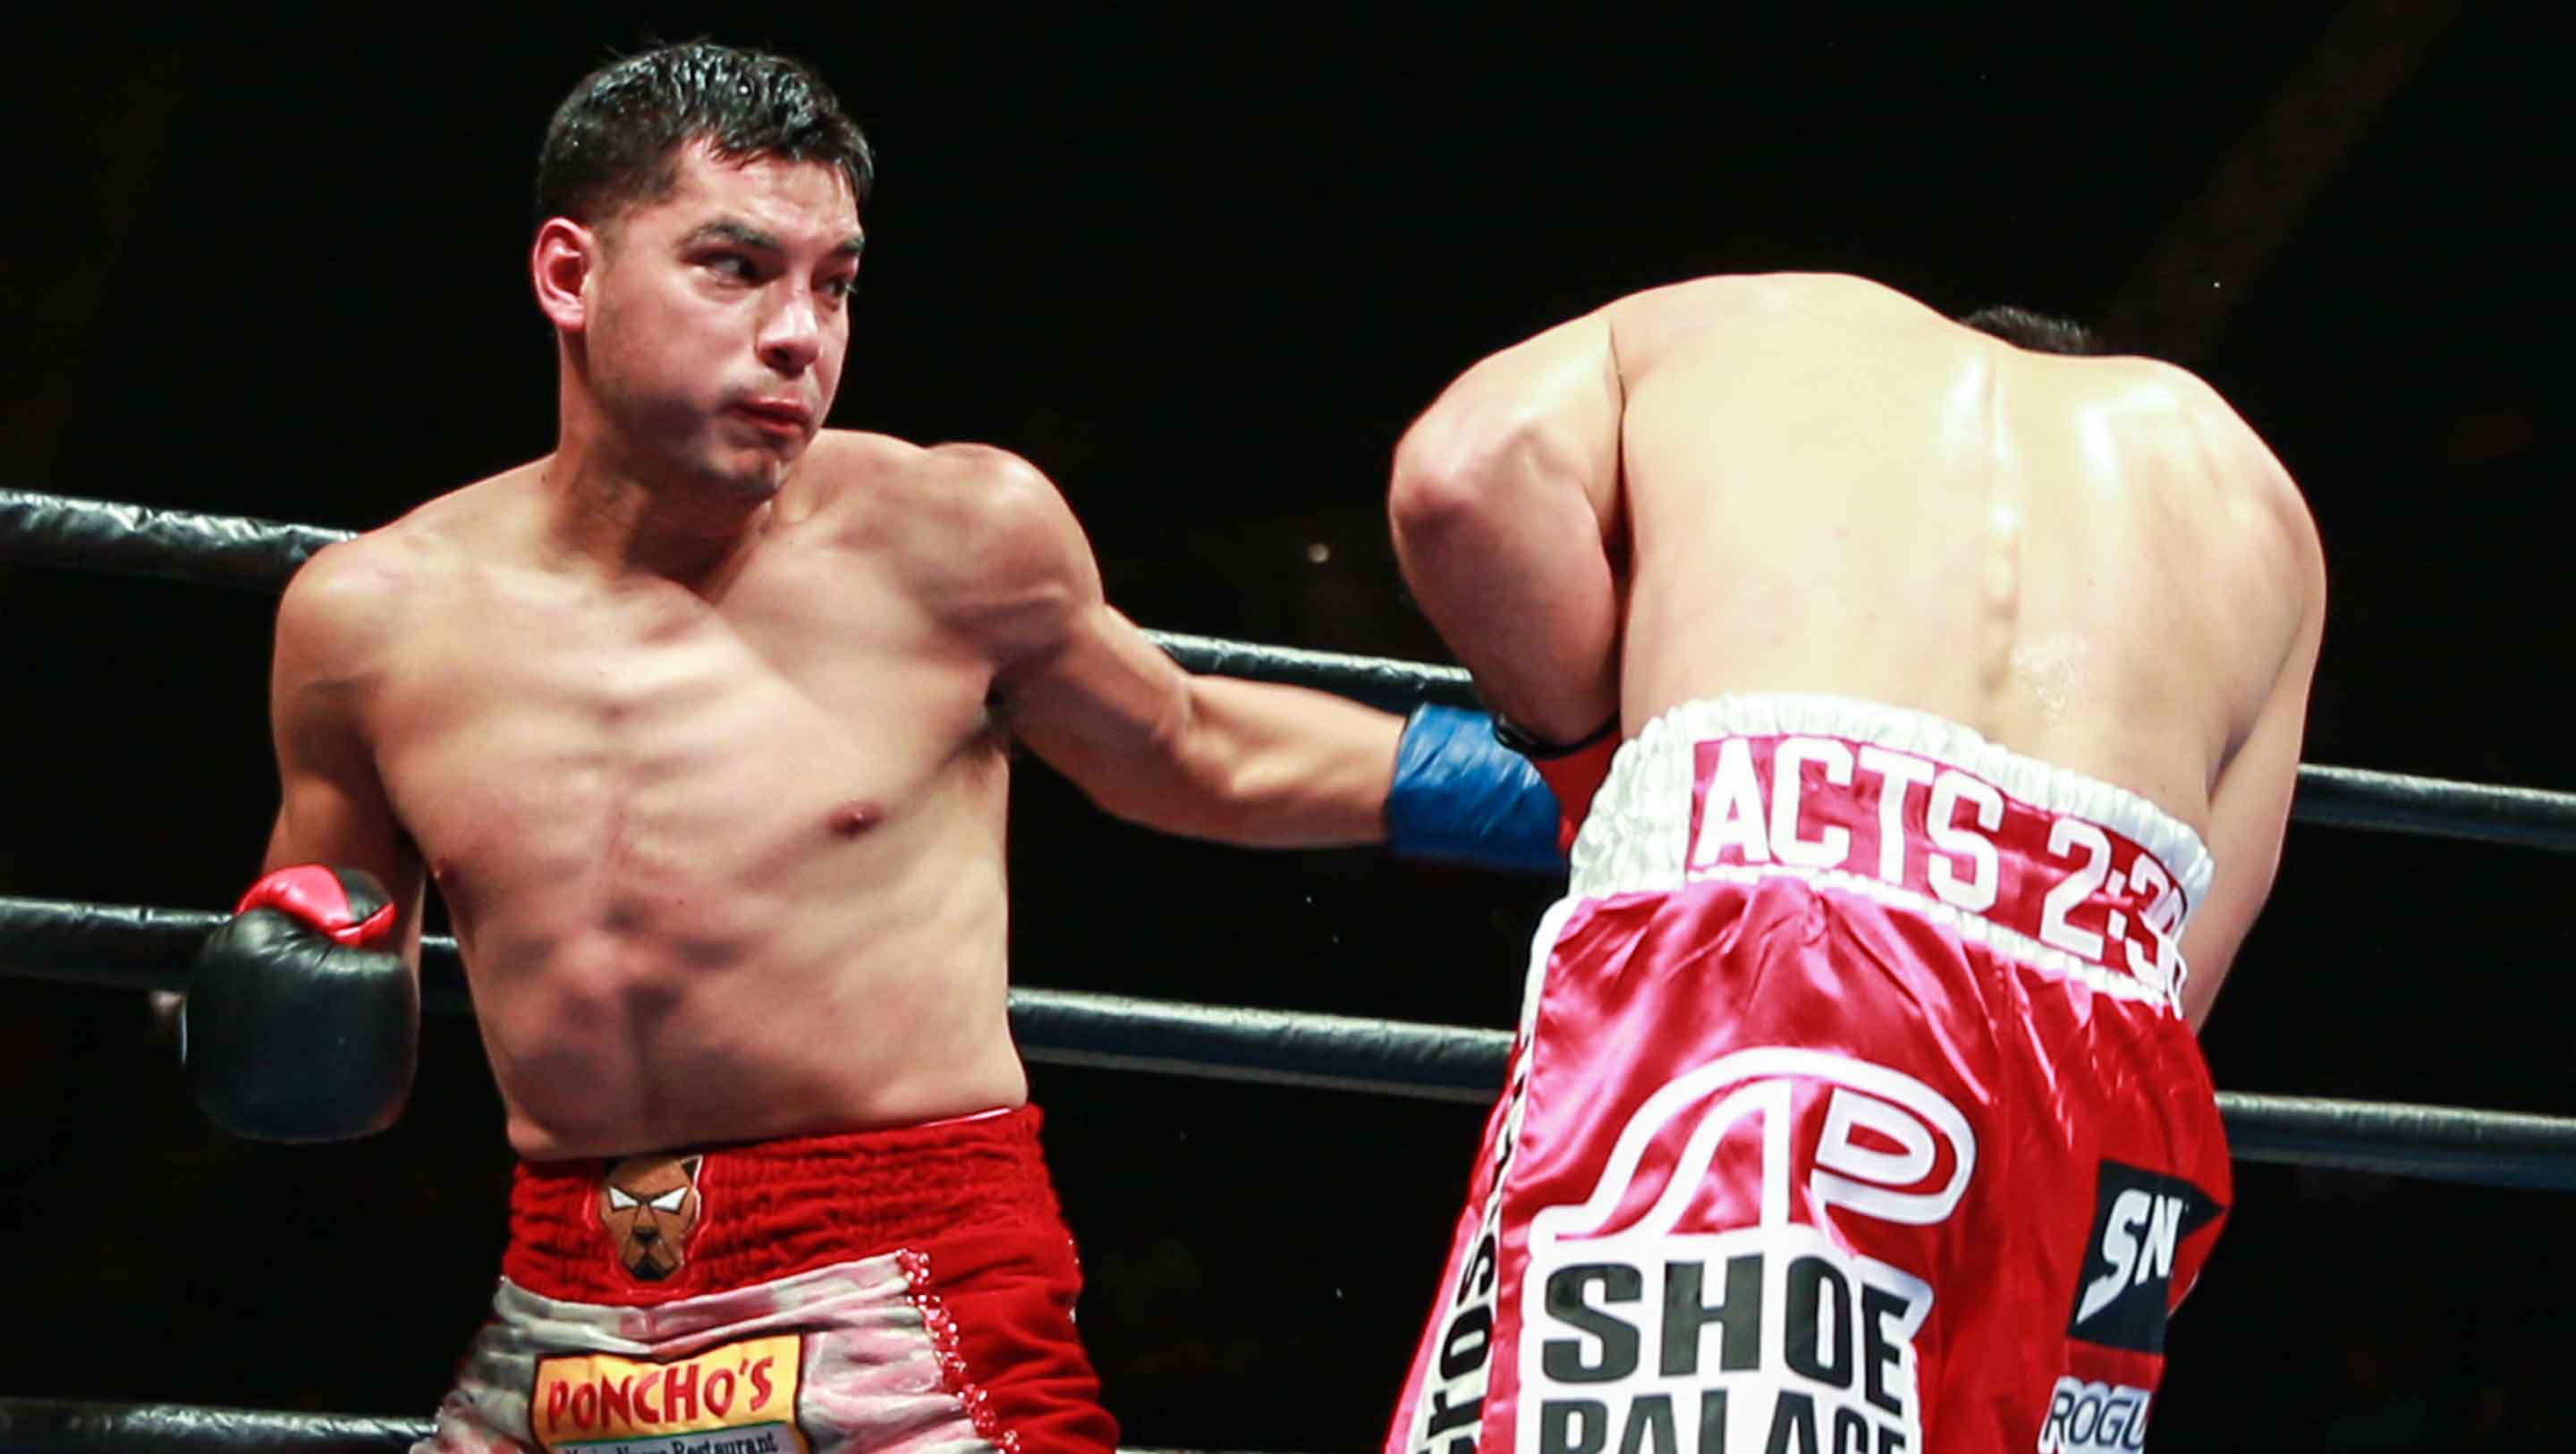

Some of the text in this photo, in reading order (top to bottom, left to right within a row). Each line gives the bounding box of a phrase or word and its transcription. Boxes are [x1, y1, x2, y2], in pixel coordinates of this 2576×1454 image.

[1691, 736, 2004, 913] ACTS
[2076, 1188, 2190, 1326] SN
[547, 1356, 775, 1433] PONCHO'S
[1541, 1252, 1911, 1419] SHOE
[1538, 1388, 1907, 1454] PALA
